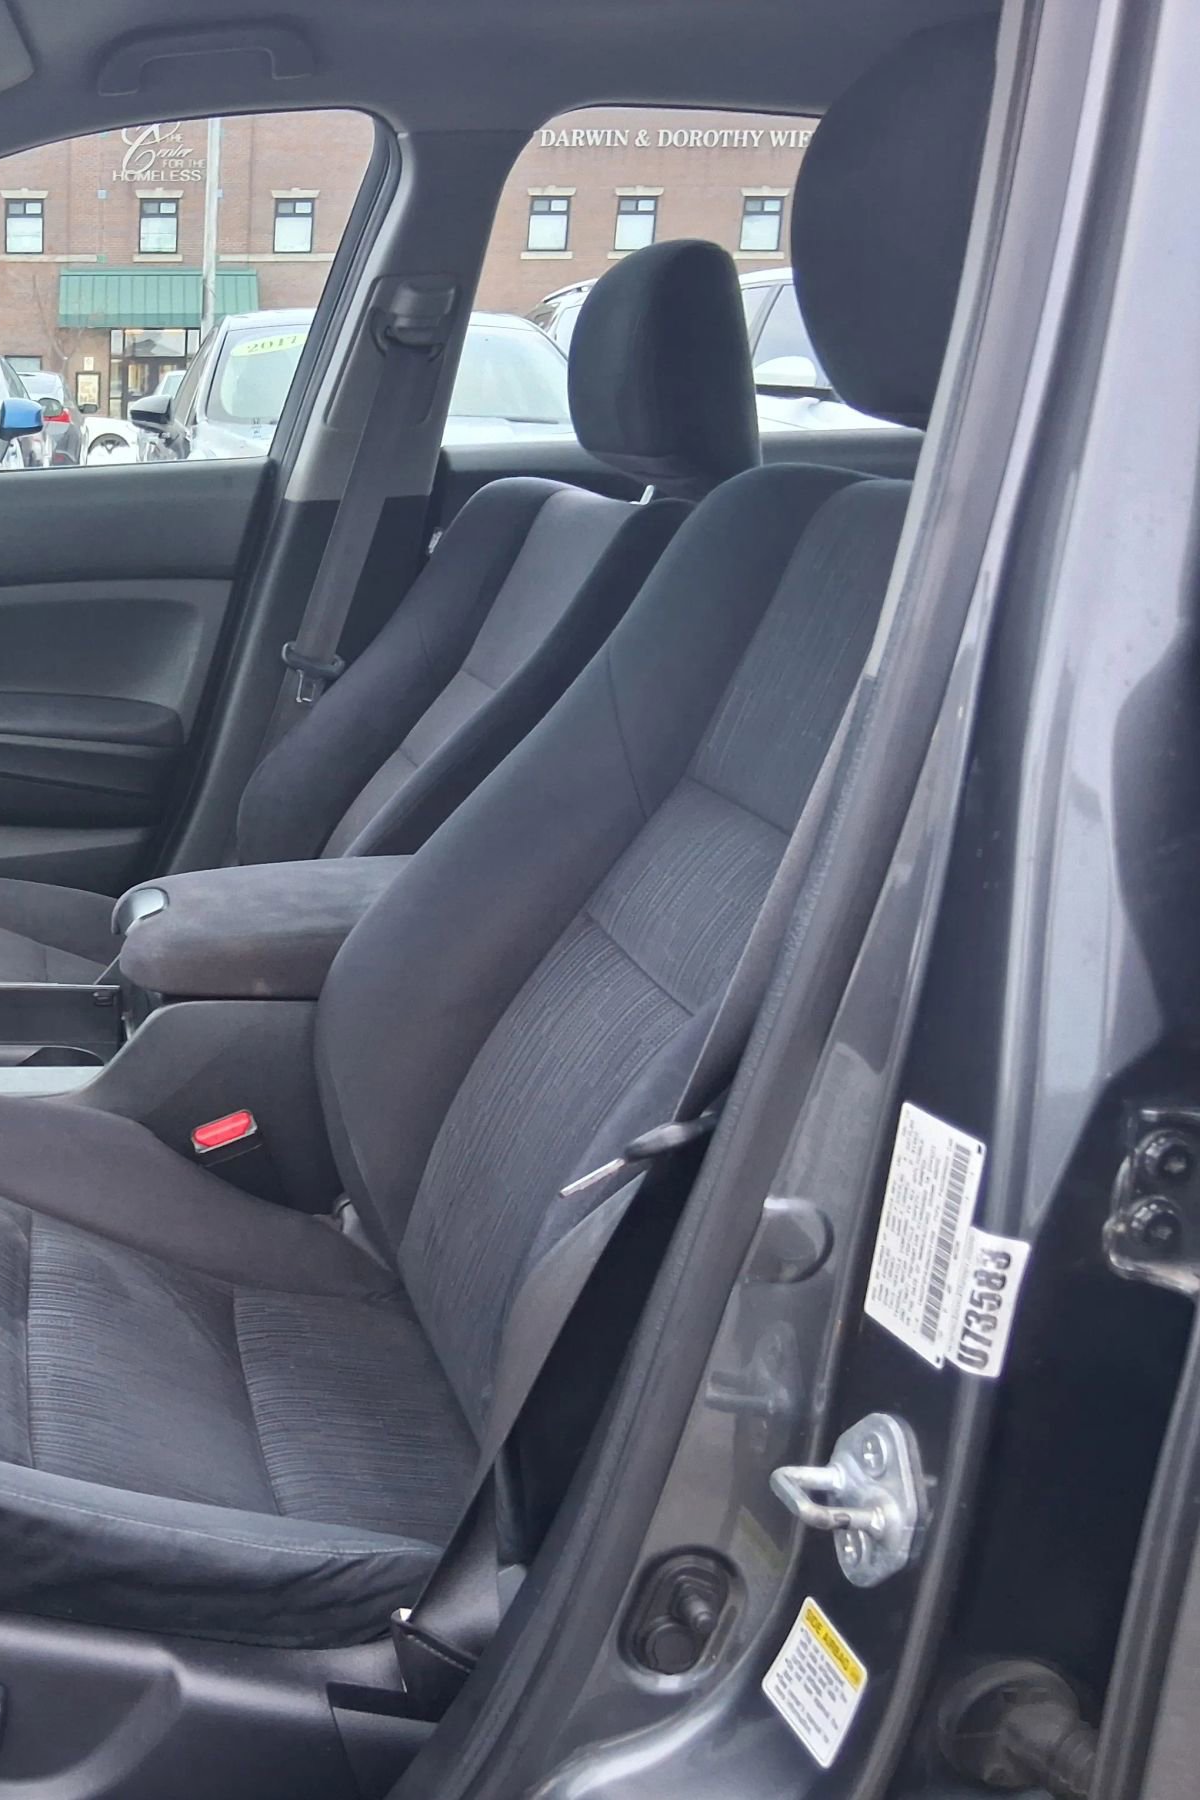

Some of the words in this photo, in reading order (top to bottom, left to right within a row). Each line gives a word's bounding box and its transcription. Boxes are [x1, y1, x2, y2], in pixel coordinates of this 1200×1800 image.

[540, 129, 630, 148] DARWIN
[635, 129, 651, 148] &
[657, 129, 764, 148] DOROTHY
[162, 158, 184, 169] FOR
[187, 158, 207, 169] THE
[112, 169, 202, 182] HOMELESS
